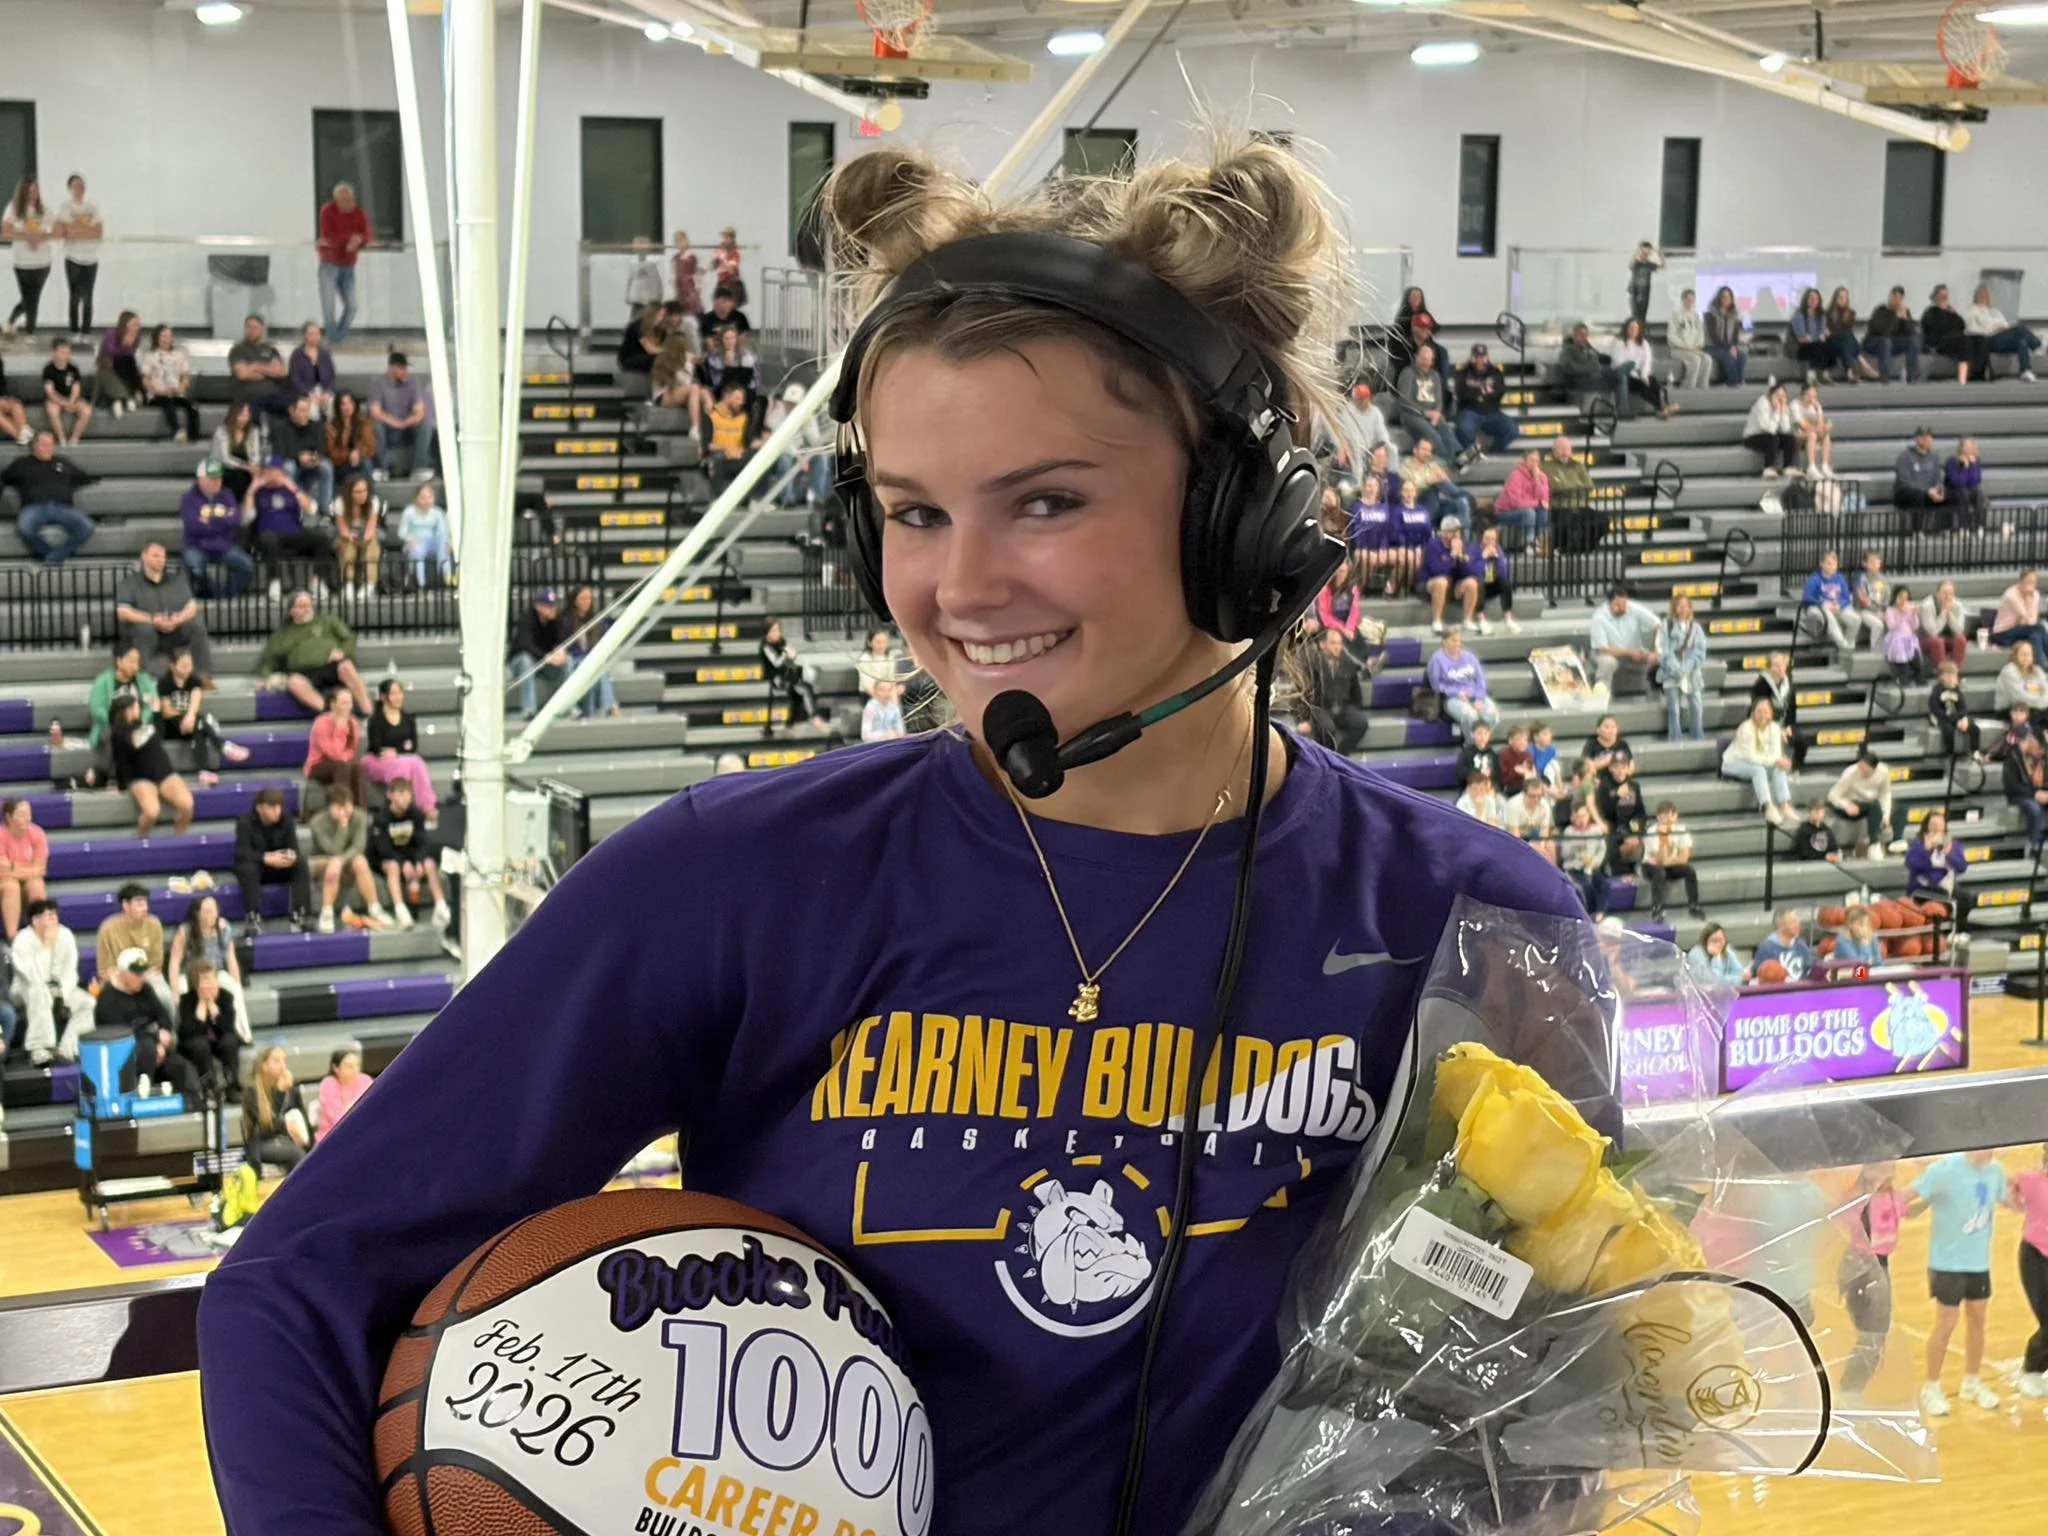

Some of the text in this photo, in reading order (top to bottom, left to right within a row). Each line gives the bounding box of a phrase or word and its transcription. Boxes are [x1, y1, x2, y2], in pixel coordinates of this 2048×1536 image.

[1729, 1026, 1866, 1067] BULLDOGS
[1735, 1007, 1860, 1038] HOME OF THE
[810, 1011, 1376, 1142] KEARNEY BULLDOGS
[597, 1234, 811, 1332] Brooke
[445, 1361, 616, 1466] 2026
[474, 1319, 642, 1413] Feb. 17th
[661, 1318, 935, 1536] 1000
[644, 1456, 820, 1536] CAREER
